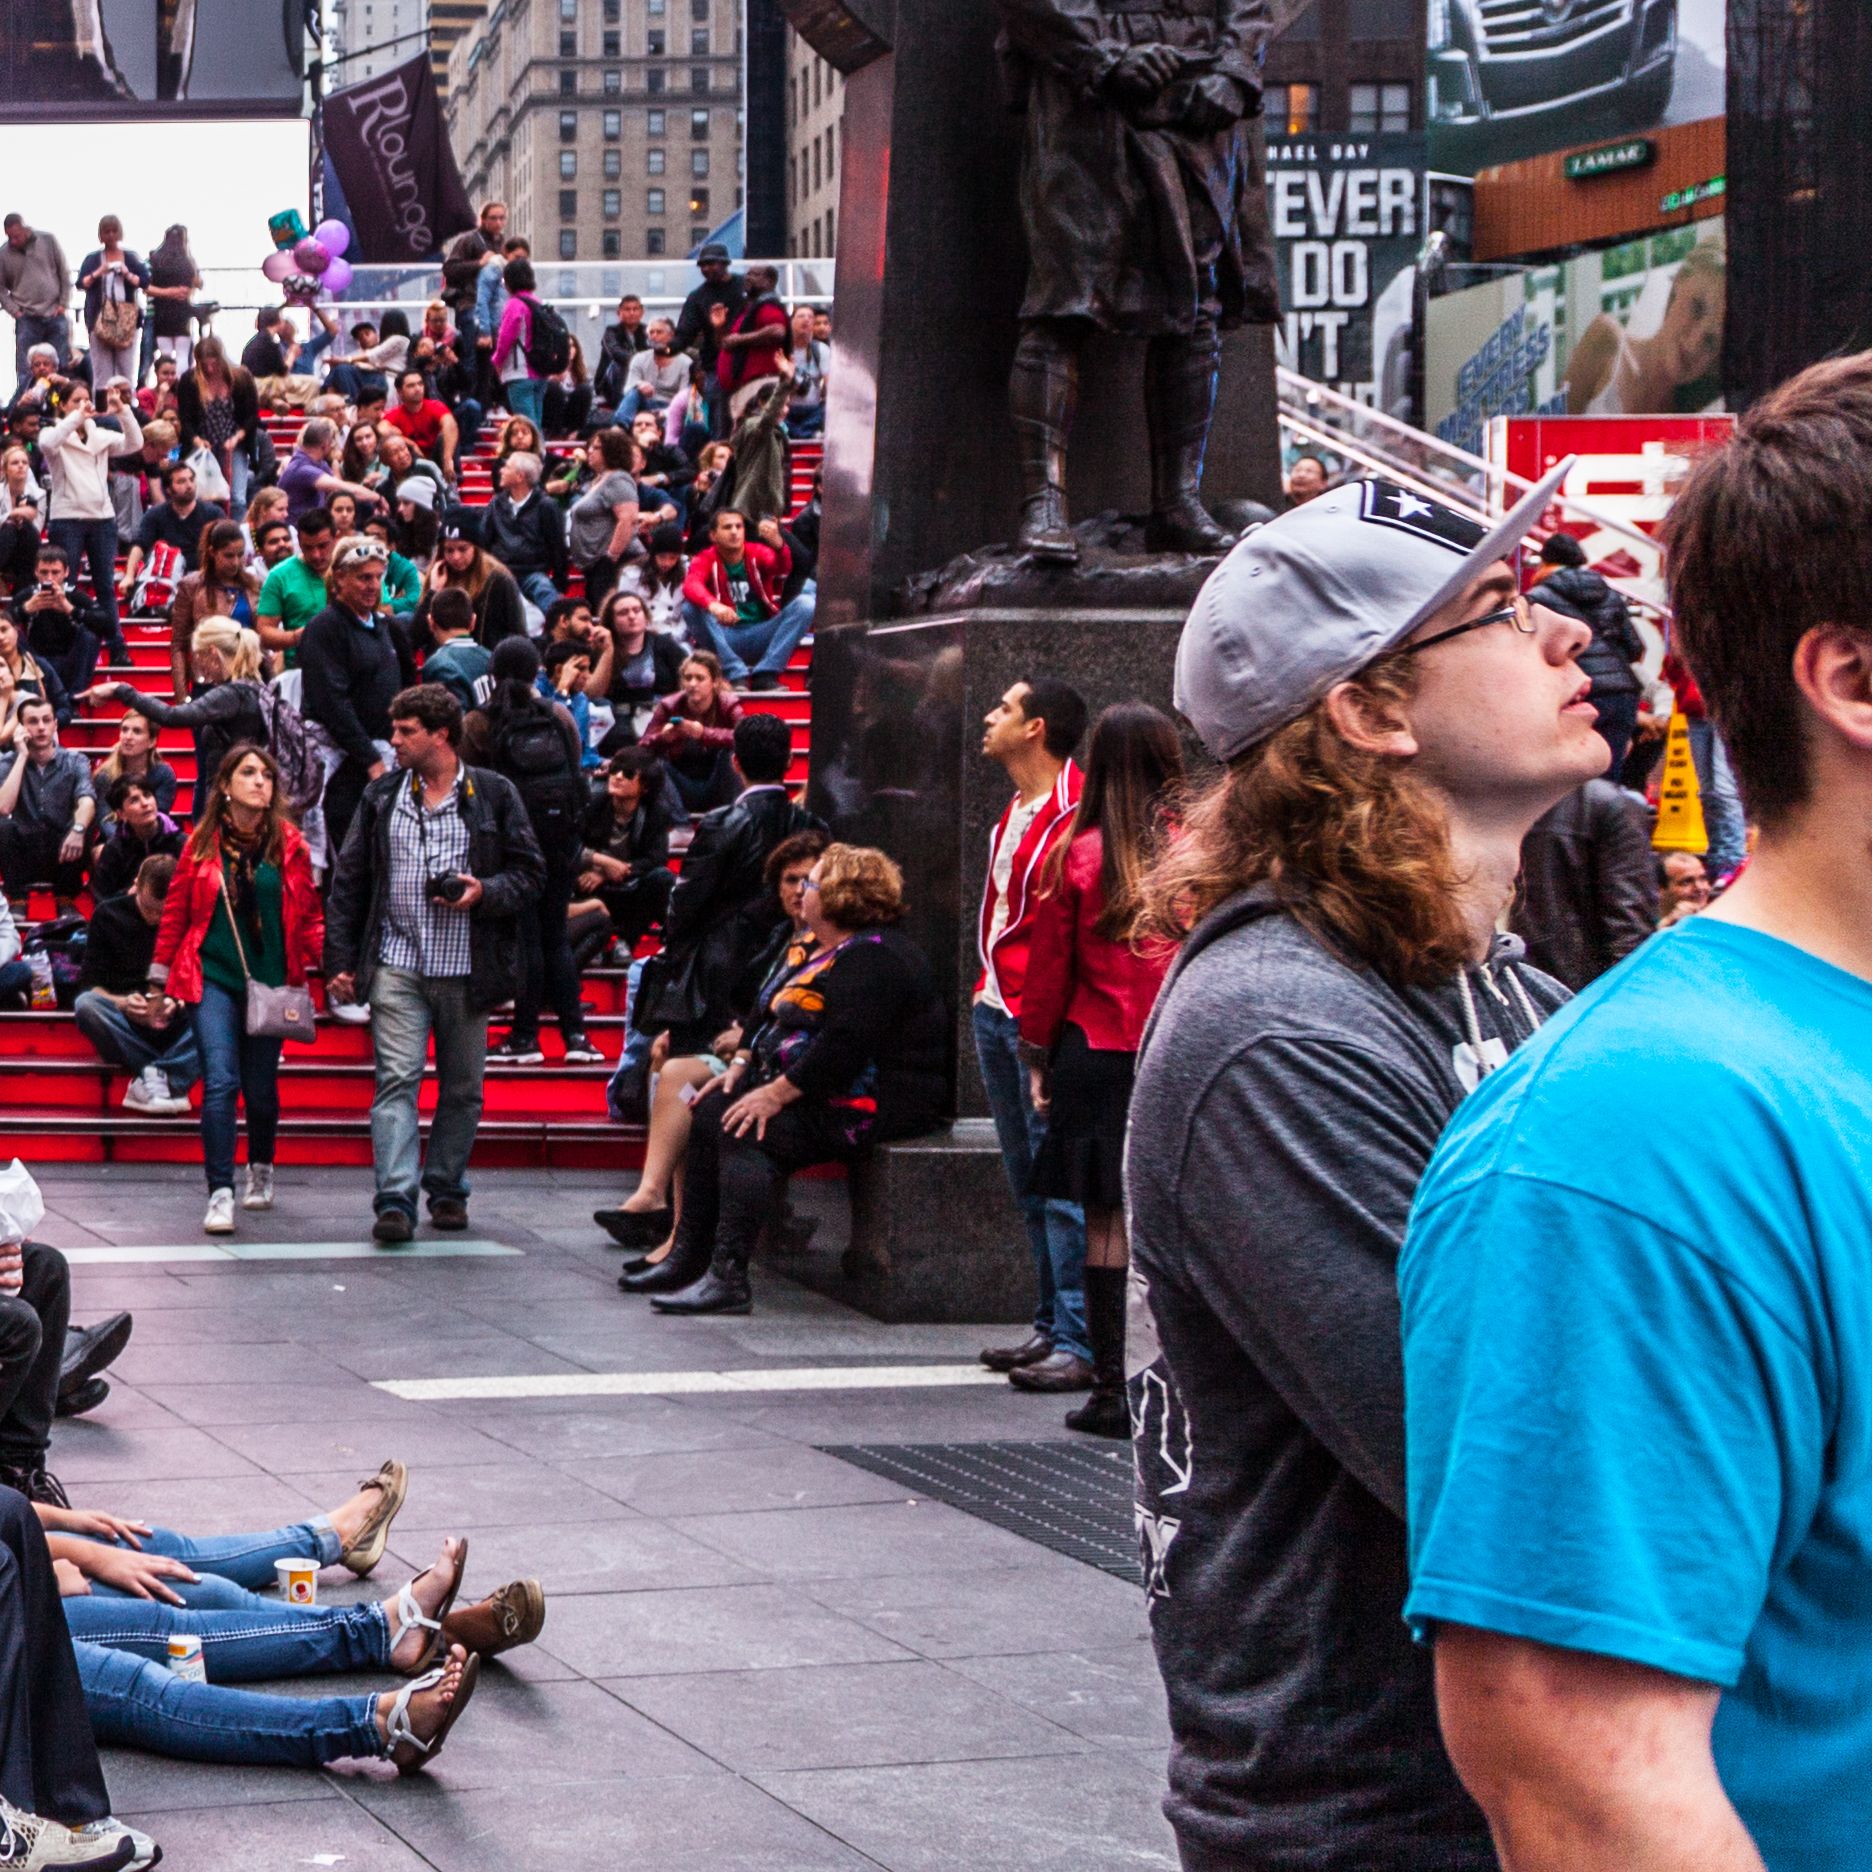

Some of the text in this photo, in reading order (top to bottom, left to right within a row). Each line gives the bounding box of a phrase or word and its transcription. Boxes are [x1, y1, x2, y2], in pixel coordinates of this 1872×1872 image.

[1265, 142, 1371, 162] HAEL BAY
[1292, 239, 1369, 308] DO
